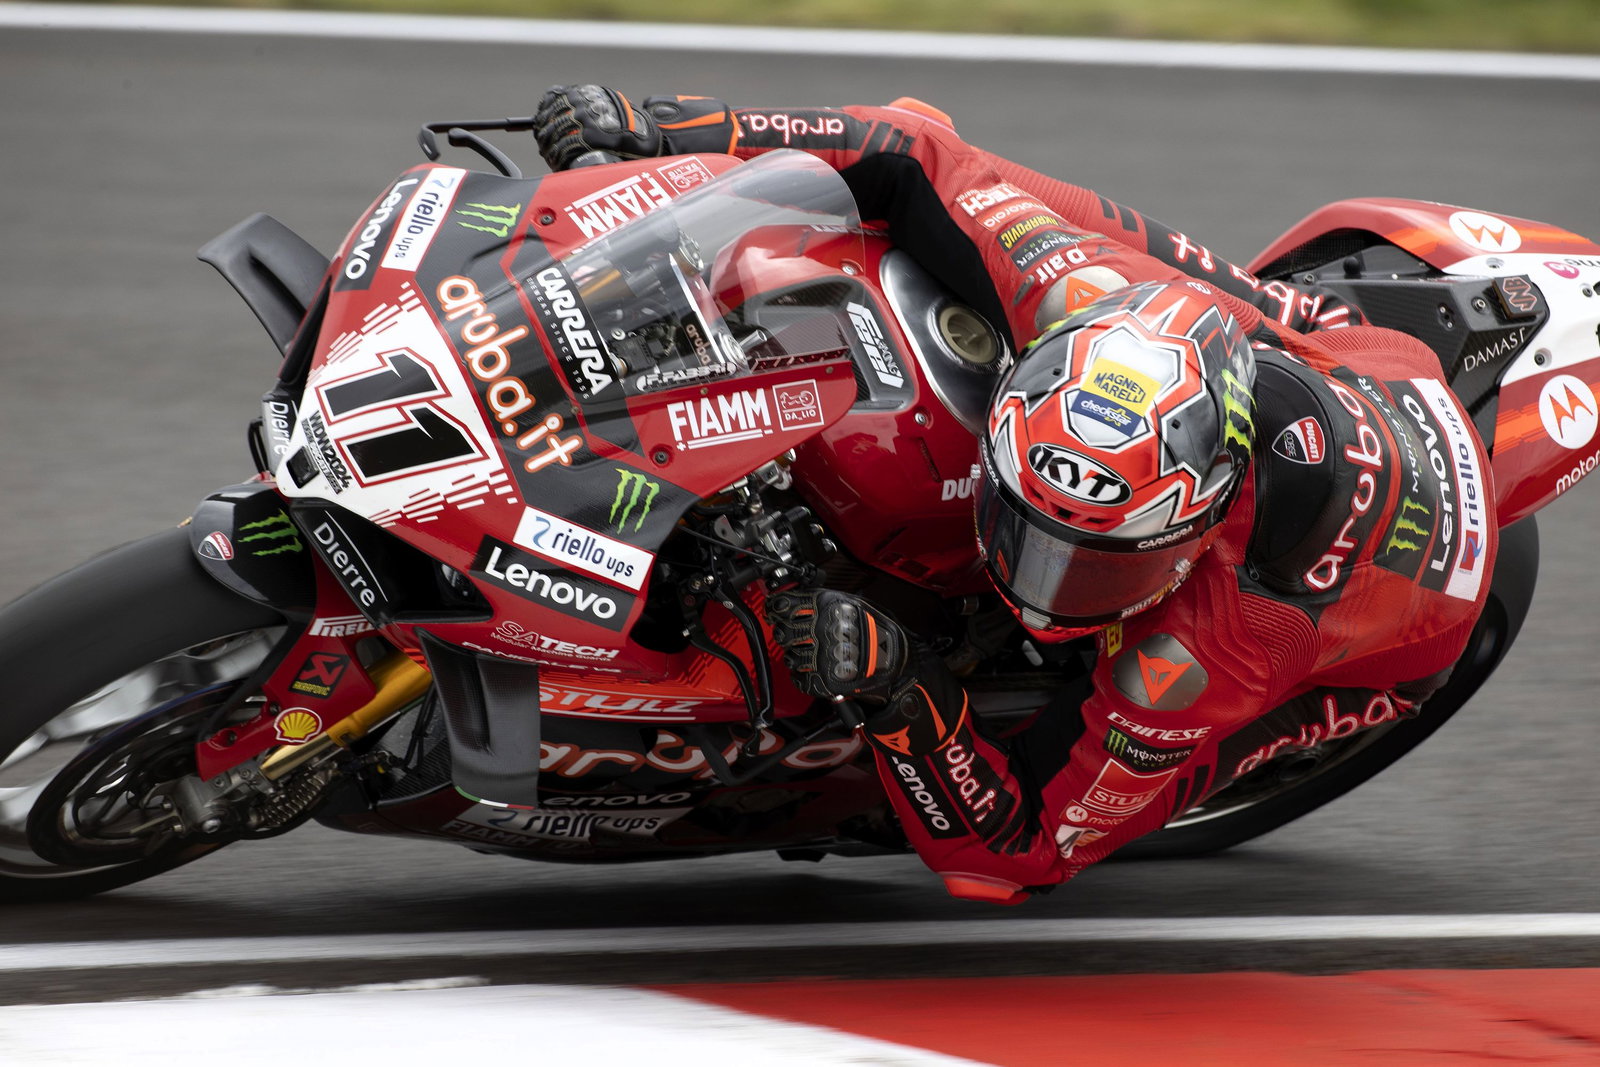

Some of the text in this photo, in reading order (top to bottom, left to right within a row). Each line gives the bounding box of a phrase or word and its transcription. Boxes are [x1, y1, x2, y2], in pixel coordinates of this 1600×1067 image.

[345, 178, 419, 280] Lenovo
[395, 192, 443, 258] riello ups
[536, 267, 613, 396] CARRERA
[686, 323, 711, 365] aruba
[1464, 327, 1525, 372] DAMAST
[438, 276, 584, 472] aruba.it
[550, 322, 573, 362] SINCE
[572, 369, 590, 400] 1956
[317, 348, 488, 486] 11
[667, 388, 771, 441] FIAMM
[1305, 422, 1320, 459] DUCATI
[1438, 397, 1479, 526] riello ups
[941, 477, 977, 501] DU
[1034, 446, 1124, 498] KYT
[1403, 394, 1453, 572] Lenovo
[552, 528, 635, 577] riello ups
[1137, 525, 1193, 549] CARRERA
[313, 522, 375, 607] Dierre
[485, 546, 616, 619] Lenovo
[490, 632, 529, 649] Modular
[531, 645, 574, 657] Machine
[496, 621, 620, 659] SATECH
[540, 686, 702, 713] STULZ
[1107, 712, 1212, 741] DAINESE
[1126, 745, 1192, 762] MONSTER
[543, 791, 693, 807] enovo
[613, 815, 661, 832] ups
